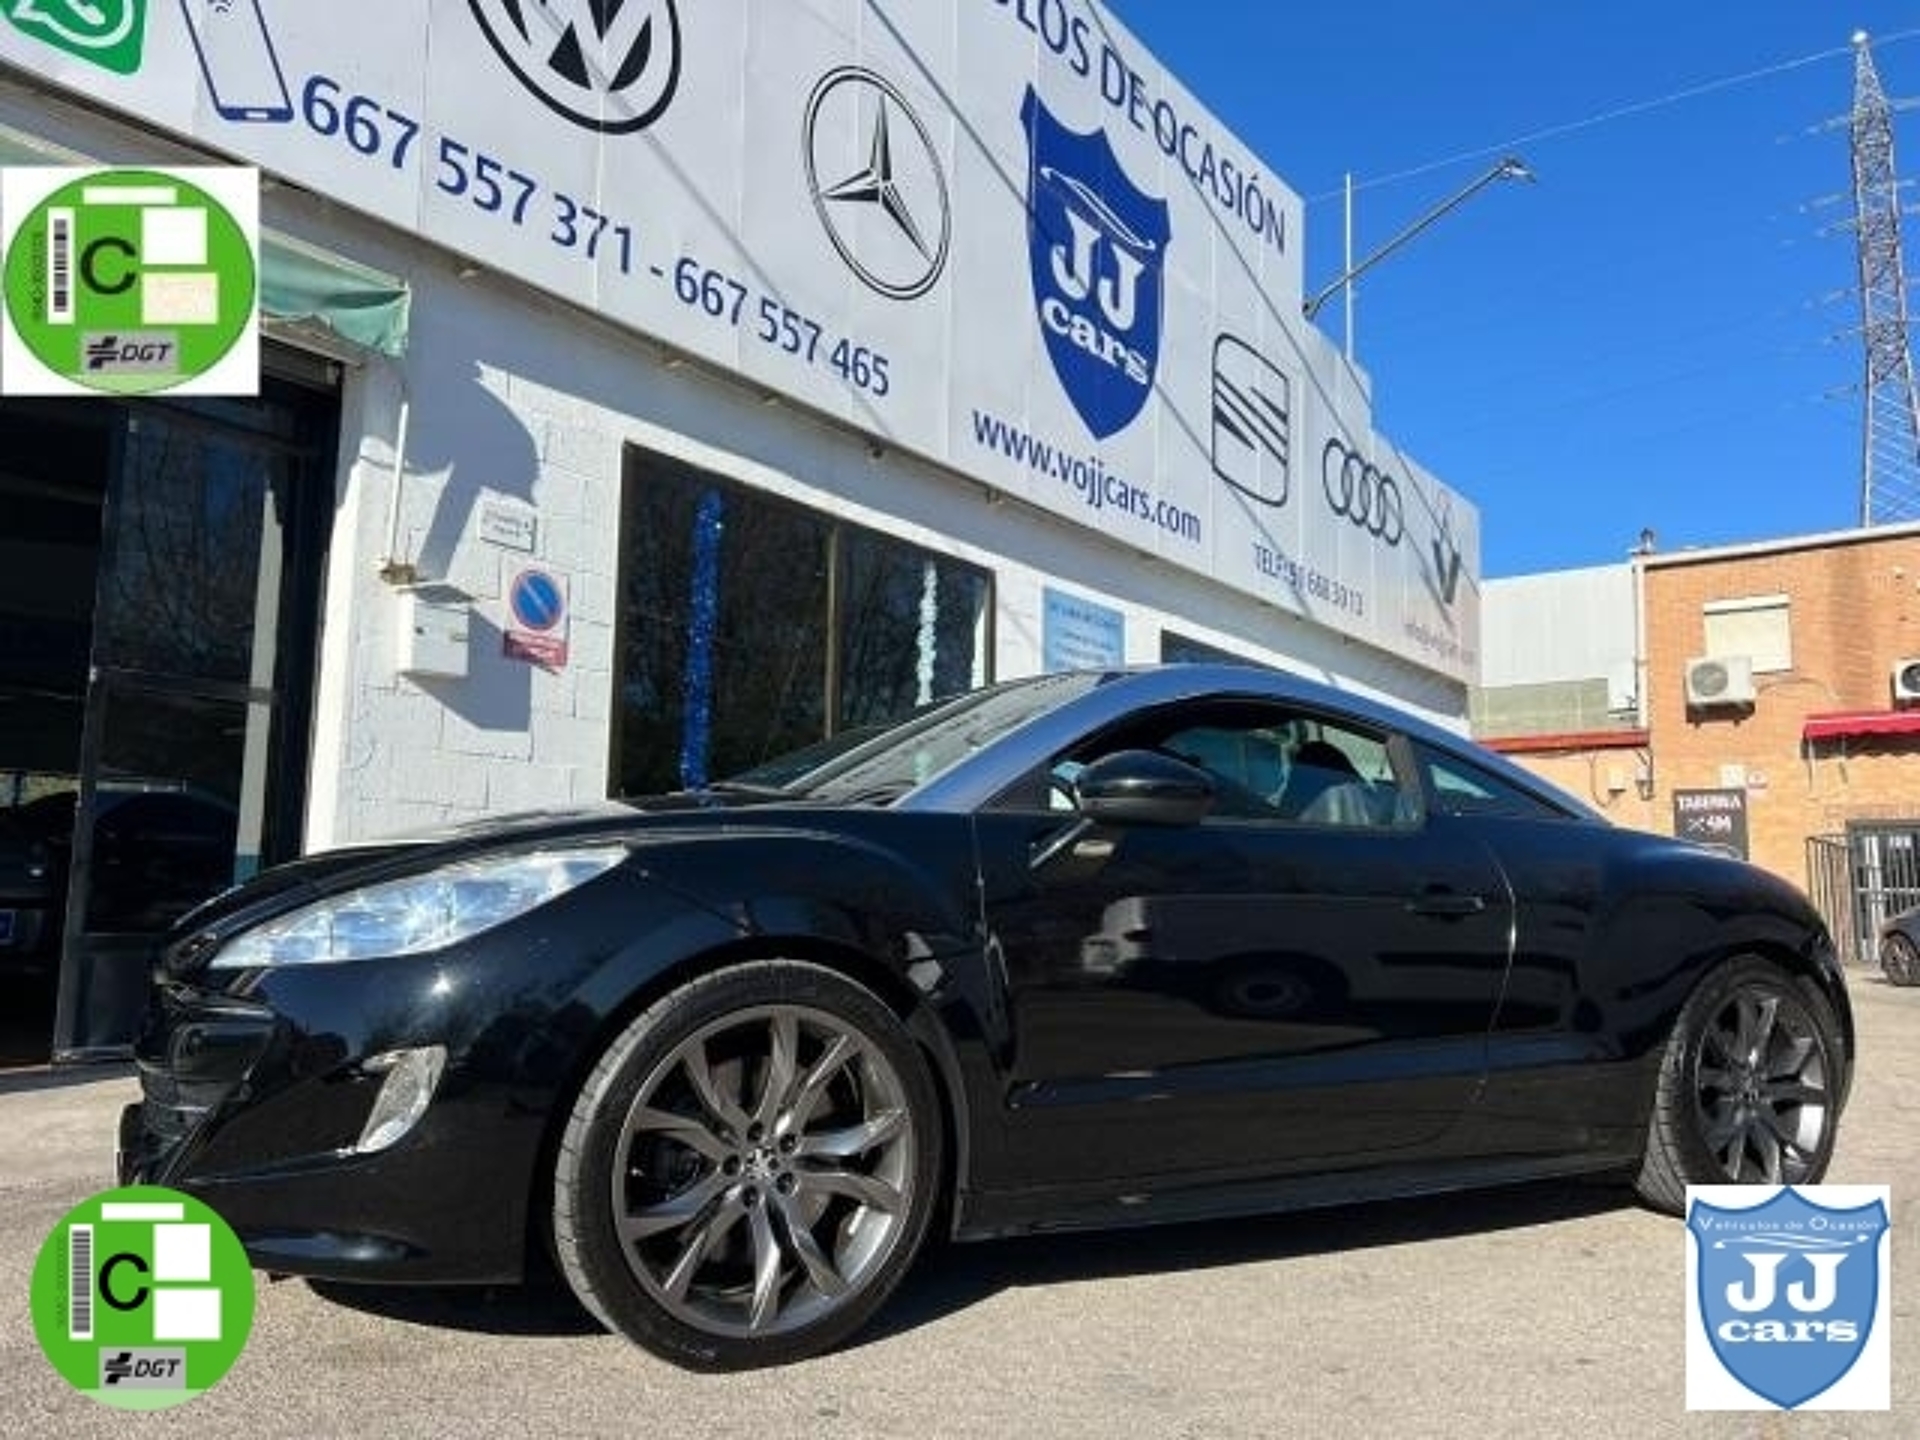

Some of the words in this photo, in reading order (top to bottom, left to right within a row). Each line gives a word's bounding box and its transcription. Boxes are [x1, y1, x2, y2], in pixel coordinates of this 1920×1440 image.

[996, 0, 1089, 76] LOS
[1101, 45, 1145, 132] DE
[1155, 99, 1285, 255] OCASIÓN
[302, 75, 419, 168] 667
[437, 137, 536, 225] 557
[551, 193, 632, 273] 371
[674, 257, 748, 325] 667
[759, 297, 822, 362] 557
[830, 338, 889, 396] 465
[1052, 206, 1145, 331] JJ
[1042, 297, 1148, 385] cars
[973, 410, 1200, 542] www.vojjcars.com
